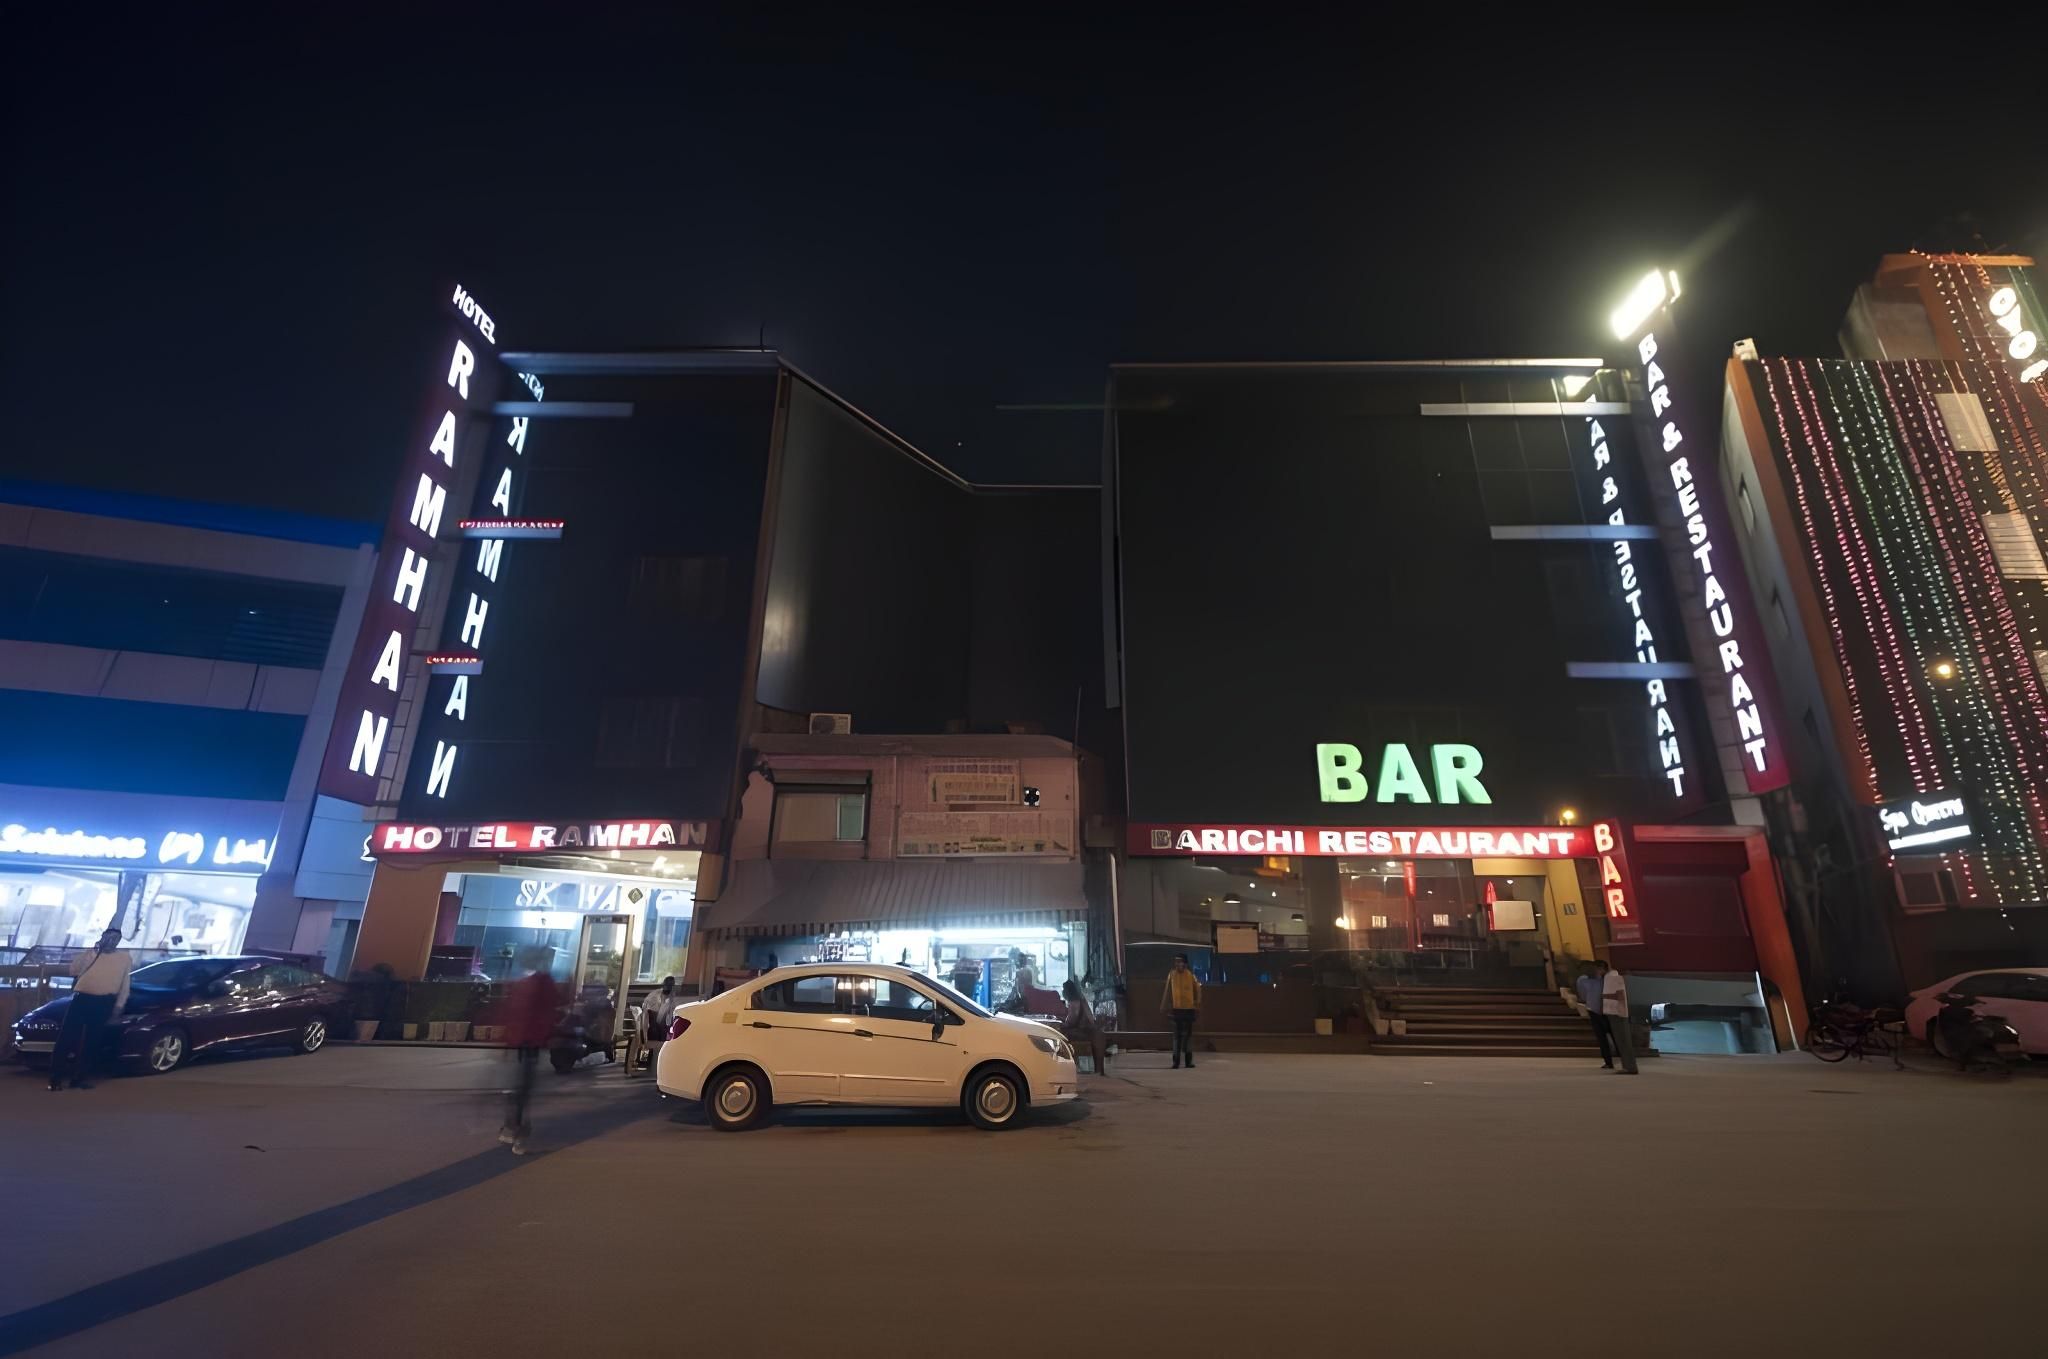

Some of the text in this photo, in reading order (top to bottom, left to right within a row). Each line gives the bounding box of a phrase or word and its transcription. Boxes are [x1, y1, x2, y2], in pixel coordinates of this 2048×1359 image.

[453, 284, 496, 345] HOTEL
[348, 339, 475, 778] RAMHAN
[1638, 332, 1766, 772] BAR & RESTAURANT
[1317, 743, 1492, 804] BAR
[383, 822, 707, 850] HOTEL RAMHAN
[1318, 830, 1574, 856] RESTAURANT
[1593, 823, 1629, 918] BAR
